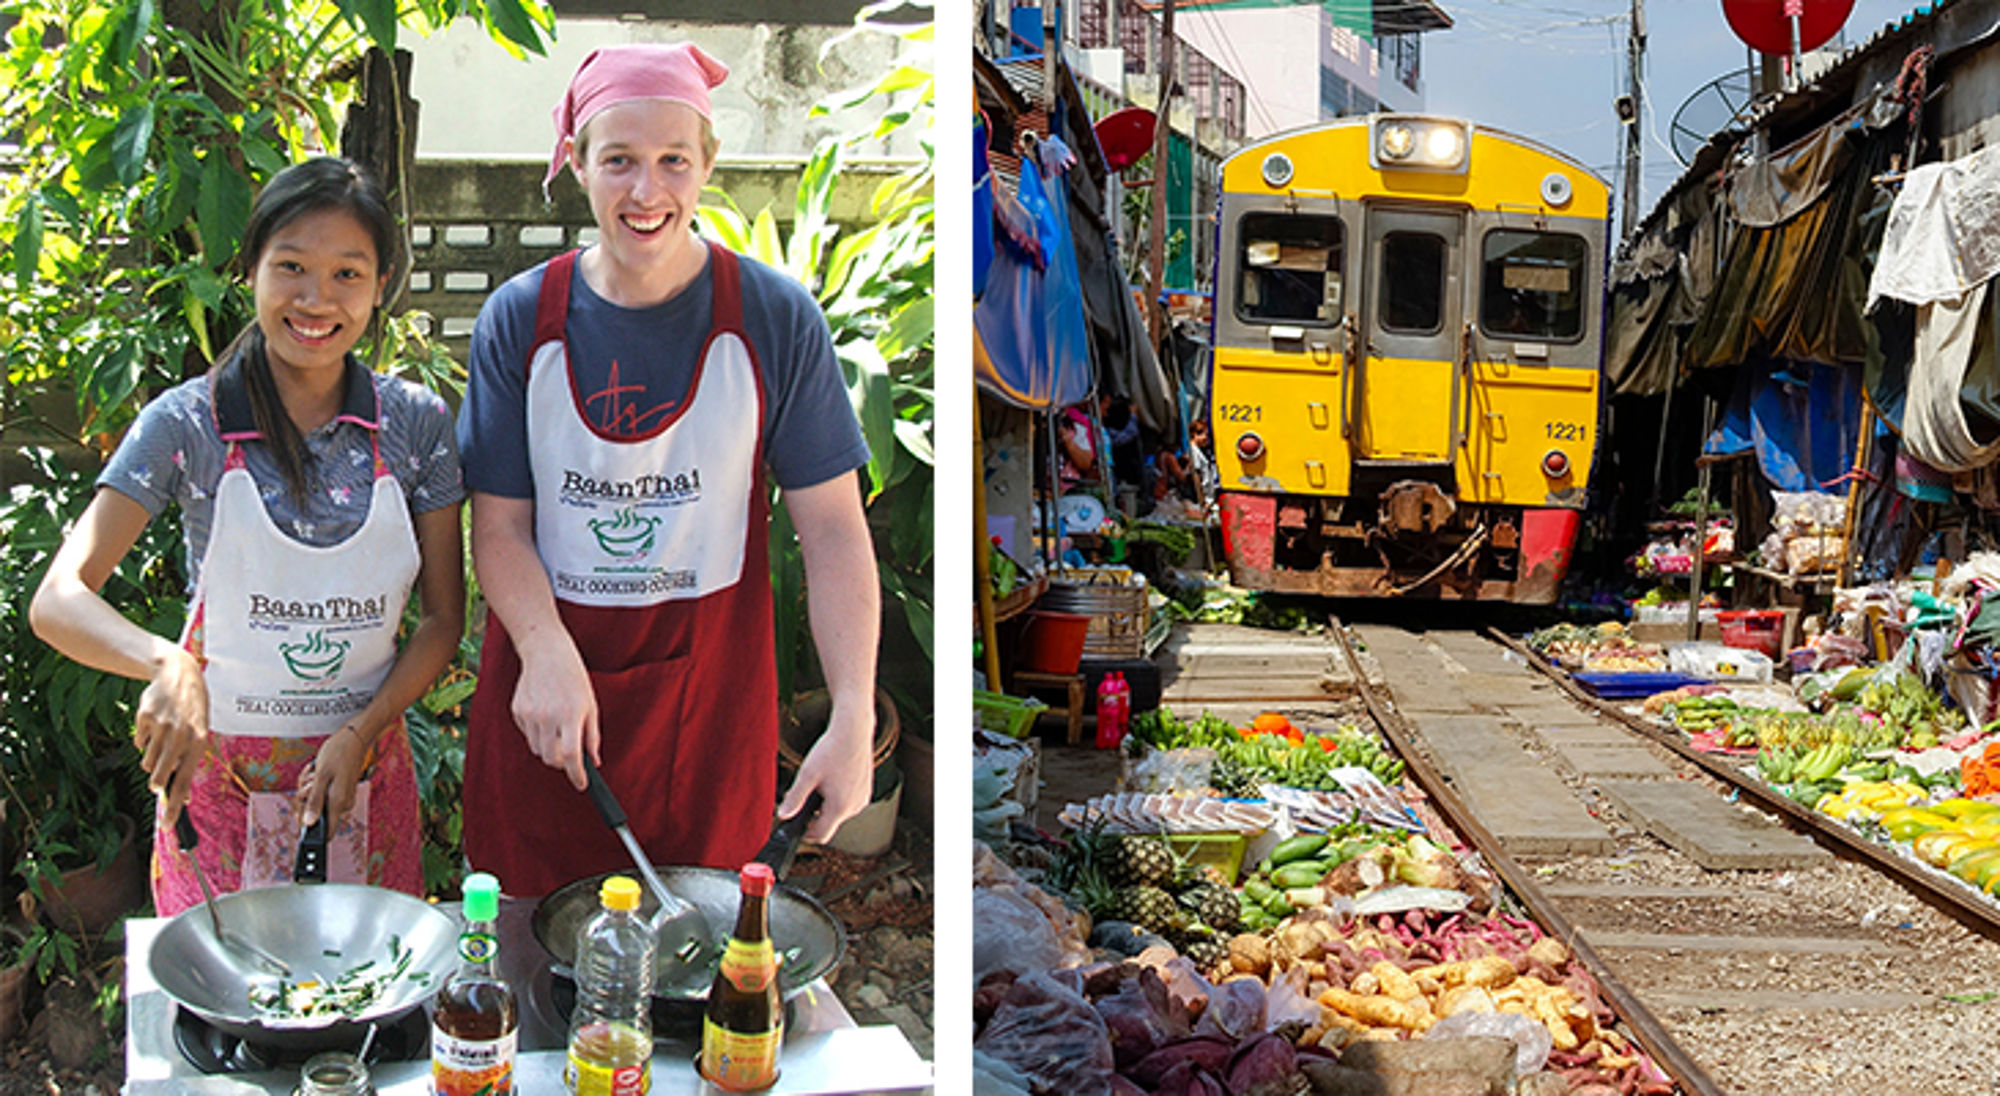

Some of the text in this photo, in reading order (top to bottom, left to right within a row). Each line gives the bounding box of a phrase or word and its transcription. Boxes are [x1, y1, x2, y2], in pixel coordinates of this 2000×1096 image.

[1221, 404, 1261, 422] 1221
[1545, 422, 1585, 441] 1221
[557, 571, 697, 594] THAI COOKING COURSE
[236, 698, 269, 713] THAI
[271, 698, 332, 716] COOKING
